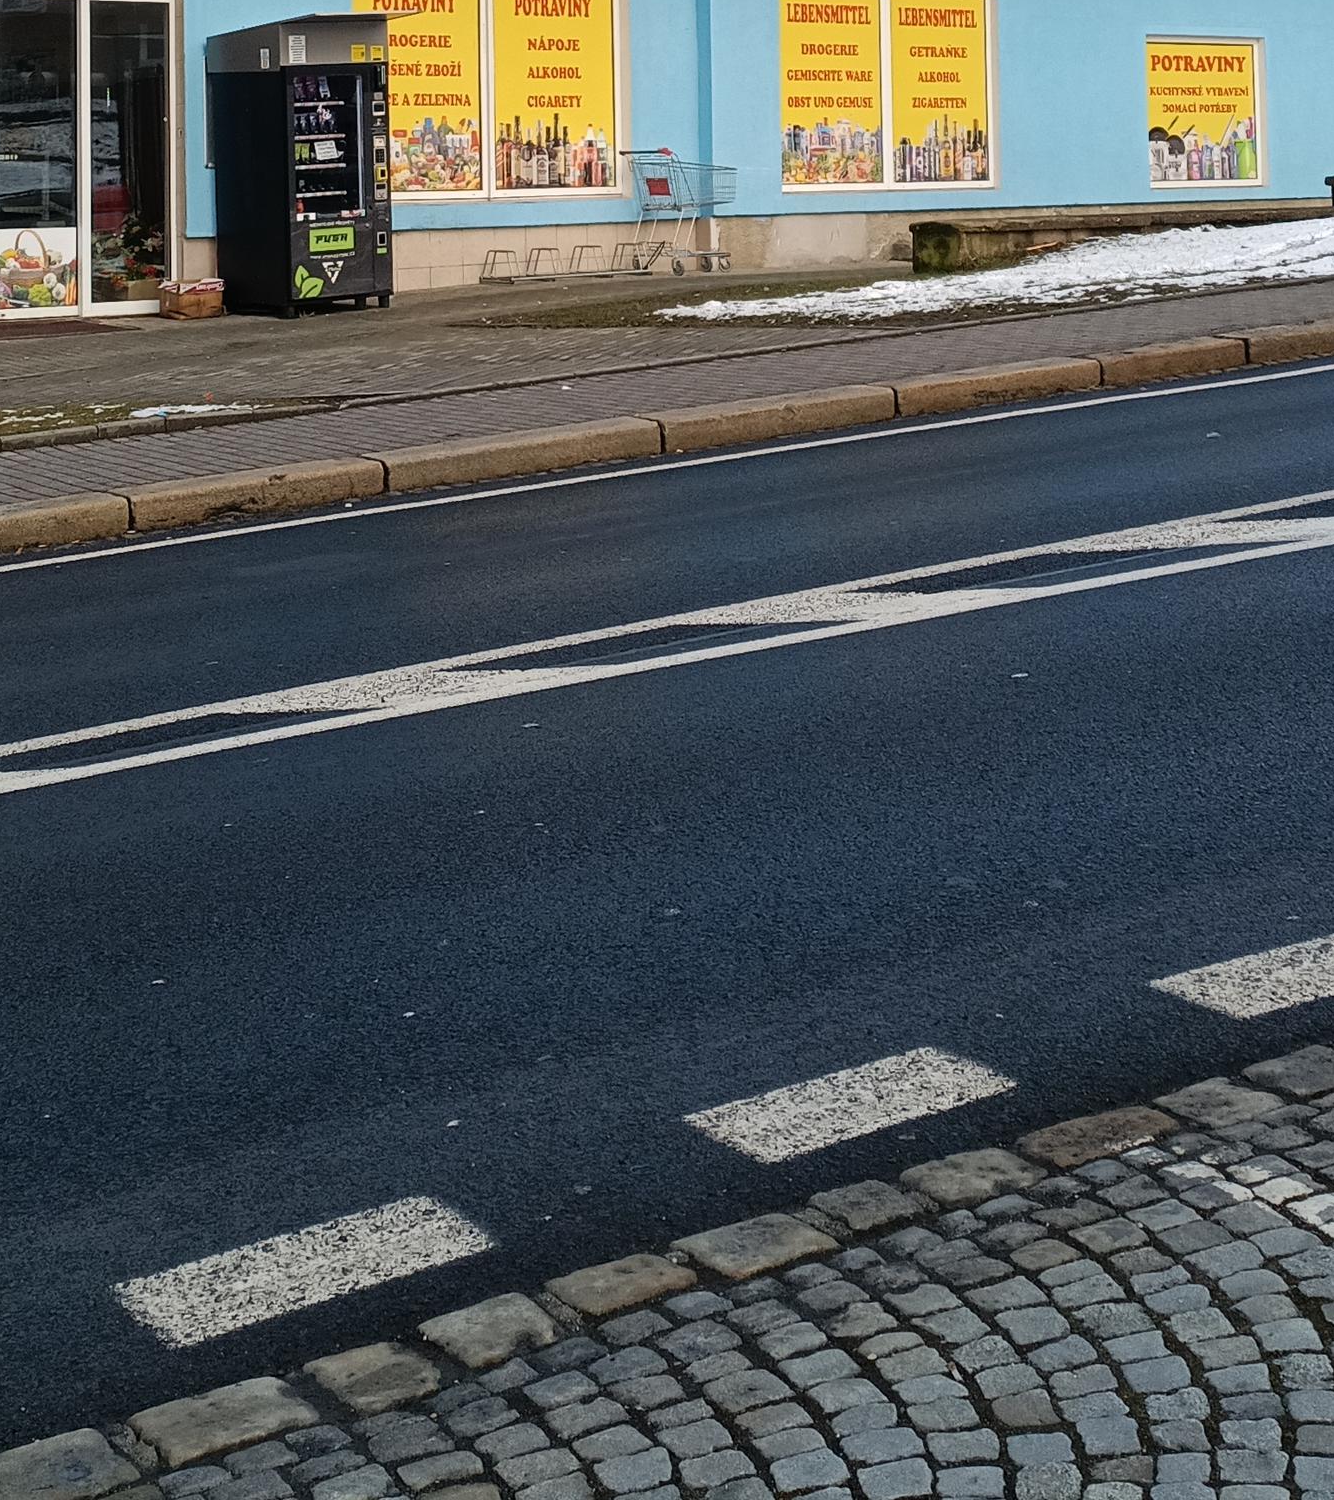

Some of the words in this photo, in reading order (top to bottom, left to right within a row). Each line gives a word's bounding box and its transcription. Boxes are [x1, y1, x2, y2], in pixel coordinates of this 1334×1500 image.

[786, 2, 872, 26] LEBENSMITTEL
[898, 6, 978, 29] LEBENSMITTEL
[388, 34, 453, 48] ROGERIE
[527, 35, 581, 52] NÁPOJE
[800, 43, 859, 56] DROGERIE
[387, 59, 423, 77] ŠENÉ
[425, 60, 462, 77] ZBOŽÍ
[1150, 54, 1246, 73] POTRAVINY
[526, 66, 582, 80] ALKOHOL
[786, 69, 843, 82] GEMISCHTE
[845, 70, 874, 83] WARE
[917, 71, 962, 83] ALKOHOL
[401, 93, 411, 107] A
[413, 93, 472, 107] ZELENINA
[526, 95, 583, 109] CIGARETY
[787, 96, 811, 109] OBST
[813, 97, 835, 109] UND
[911, 97, 968, 109] ZIGARETTEN
